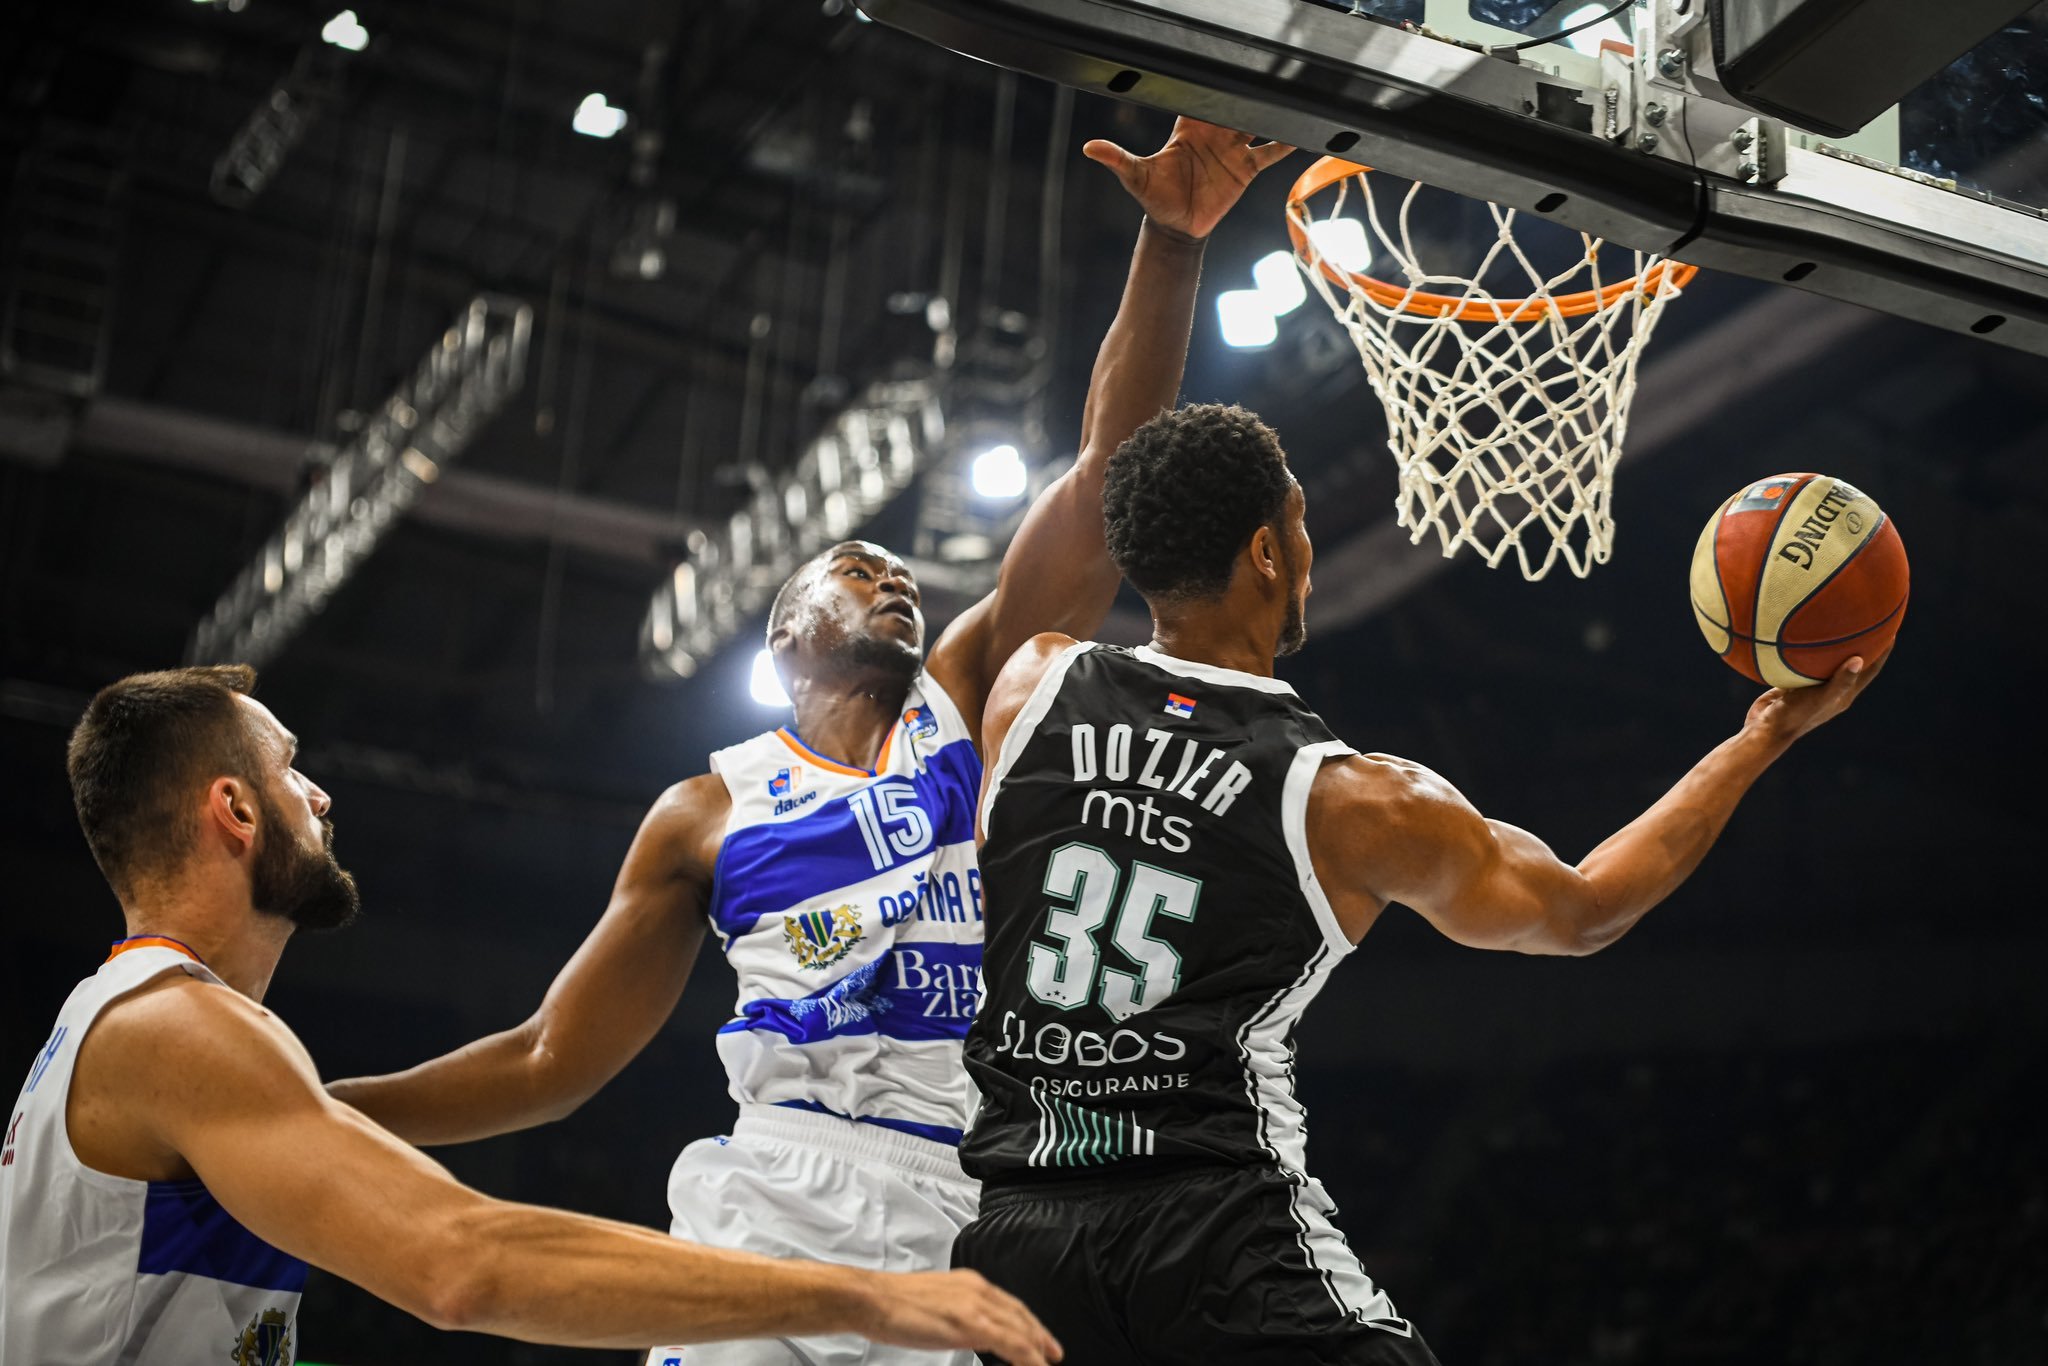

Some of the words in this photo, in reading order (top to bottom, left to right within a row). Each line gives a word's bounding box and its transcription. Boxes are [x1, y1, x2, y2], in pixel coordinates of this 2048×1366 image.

[1778, 483, 1856, 571] ALDING
[1071, 723, 1253, 817] DOZIER
[847, 782, 934, 872] 15
[1080, 788, 1194, 854] mts
[892, 949, 982, 991] Bar
[1026, 841, 1204, 1024] 35
[1031, 1073, 1190, 1098] OSIGURANJE
